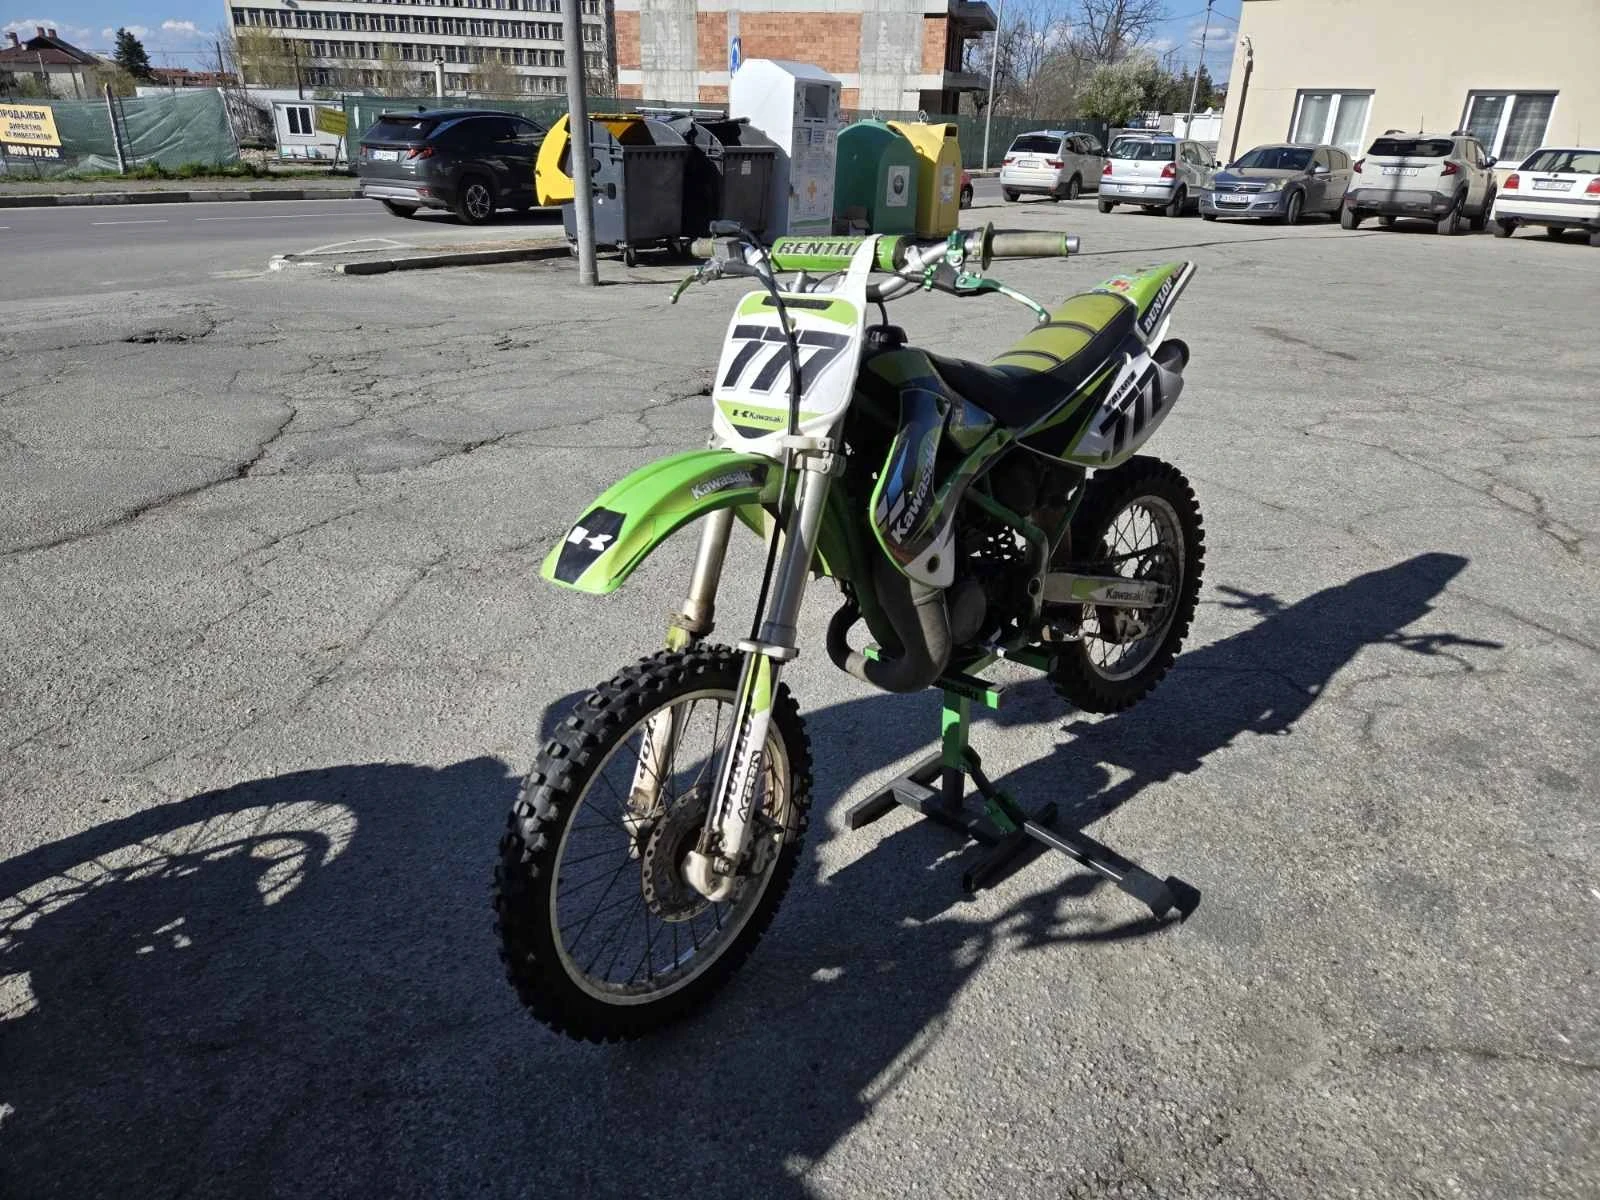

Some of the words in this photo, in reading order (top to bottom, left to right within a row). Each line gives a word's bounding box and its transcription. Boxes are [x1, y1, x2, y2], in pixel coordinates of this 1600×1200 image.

[776, 240, 885, 257] RENTHL
[1144, 277, 1173, 332] DUNLOP
[721, 324, 851, 397] 777
[749, 411, 784, 424] Kawasaki
[1099, 361, 1162, 457] 777
[690, 470, 754, 500] Kawasaki
[1105, 587, 1144, 601] Kawasaki
[737, 750, 762, 823] ACERBIS
